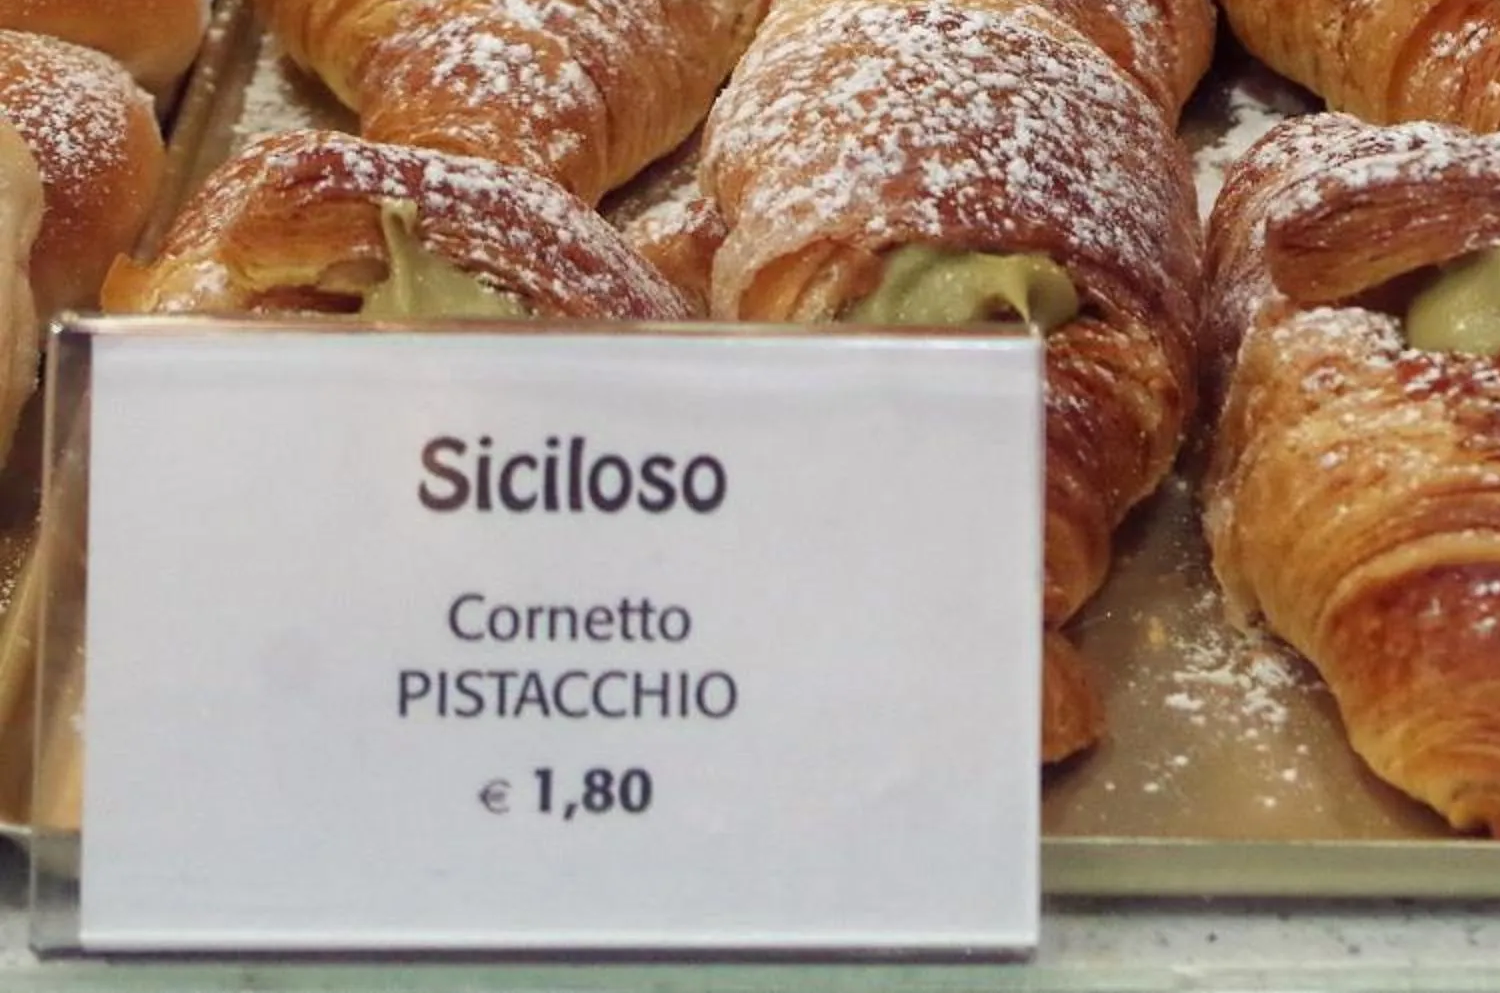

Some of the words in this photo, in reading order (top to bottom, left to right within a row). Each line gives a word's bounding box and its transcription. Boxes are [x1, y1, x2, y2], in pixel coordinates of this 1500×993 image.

[418, 436, 727, 514] Siciloso
[448, 593, 691, 643] Cornetto
[399, 670, 738, 719] PISTACCHIO
[477, 780, 510, 814] €
[535, 768, 653, 822] 1,80
